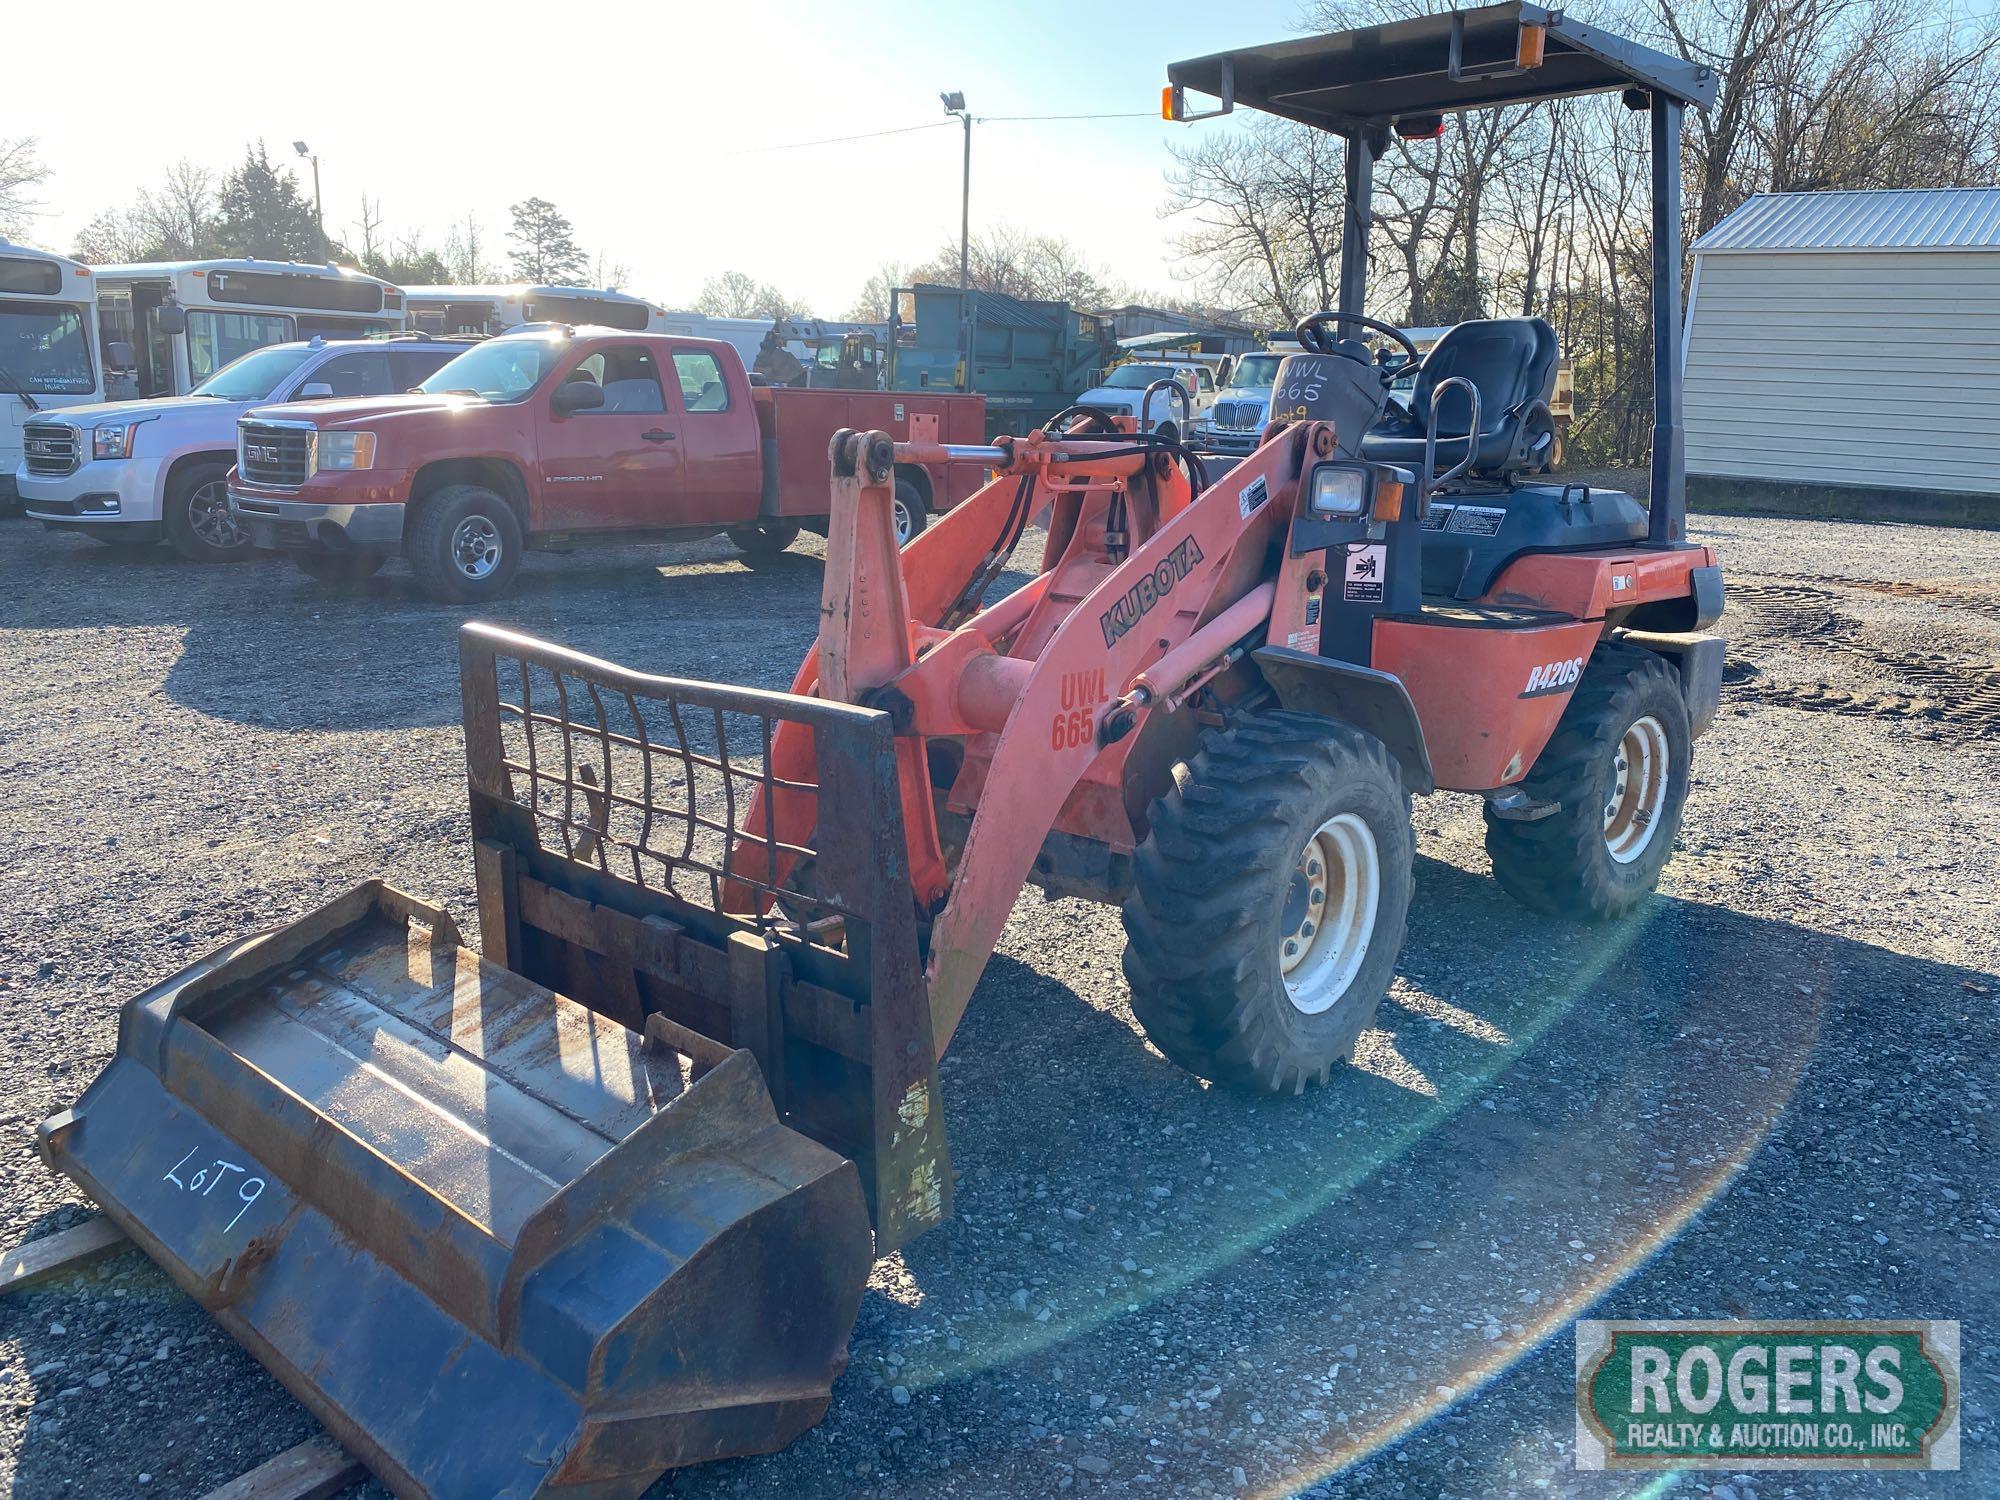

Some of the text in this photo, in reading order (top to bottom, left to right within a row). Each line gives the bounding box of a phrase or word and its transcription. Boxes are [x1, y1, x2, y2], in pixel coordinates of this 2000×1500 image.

[215, 274, 229, 291] T
[526, 303, 535, 317] T
[1277, 382, 1321, 401] 665
[1297, 405, 1307, 421] 9
[30, 441, 51, 453] GMC
[247, 445, 278, 463] GMC
[1100, 534, 1204, 649] KUBOTA
[1525, 657, 1583, 693] R420S
[1061, 667, 1109, 711] UWL
[1052, 707, 1094, 751] 665
[224, 1177, 265, 1233] 9
